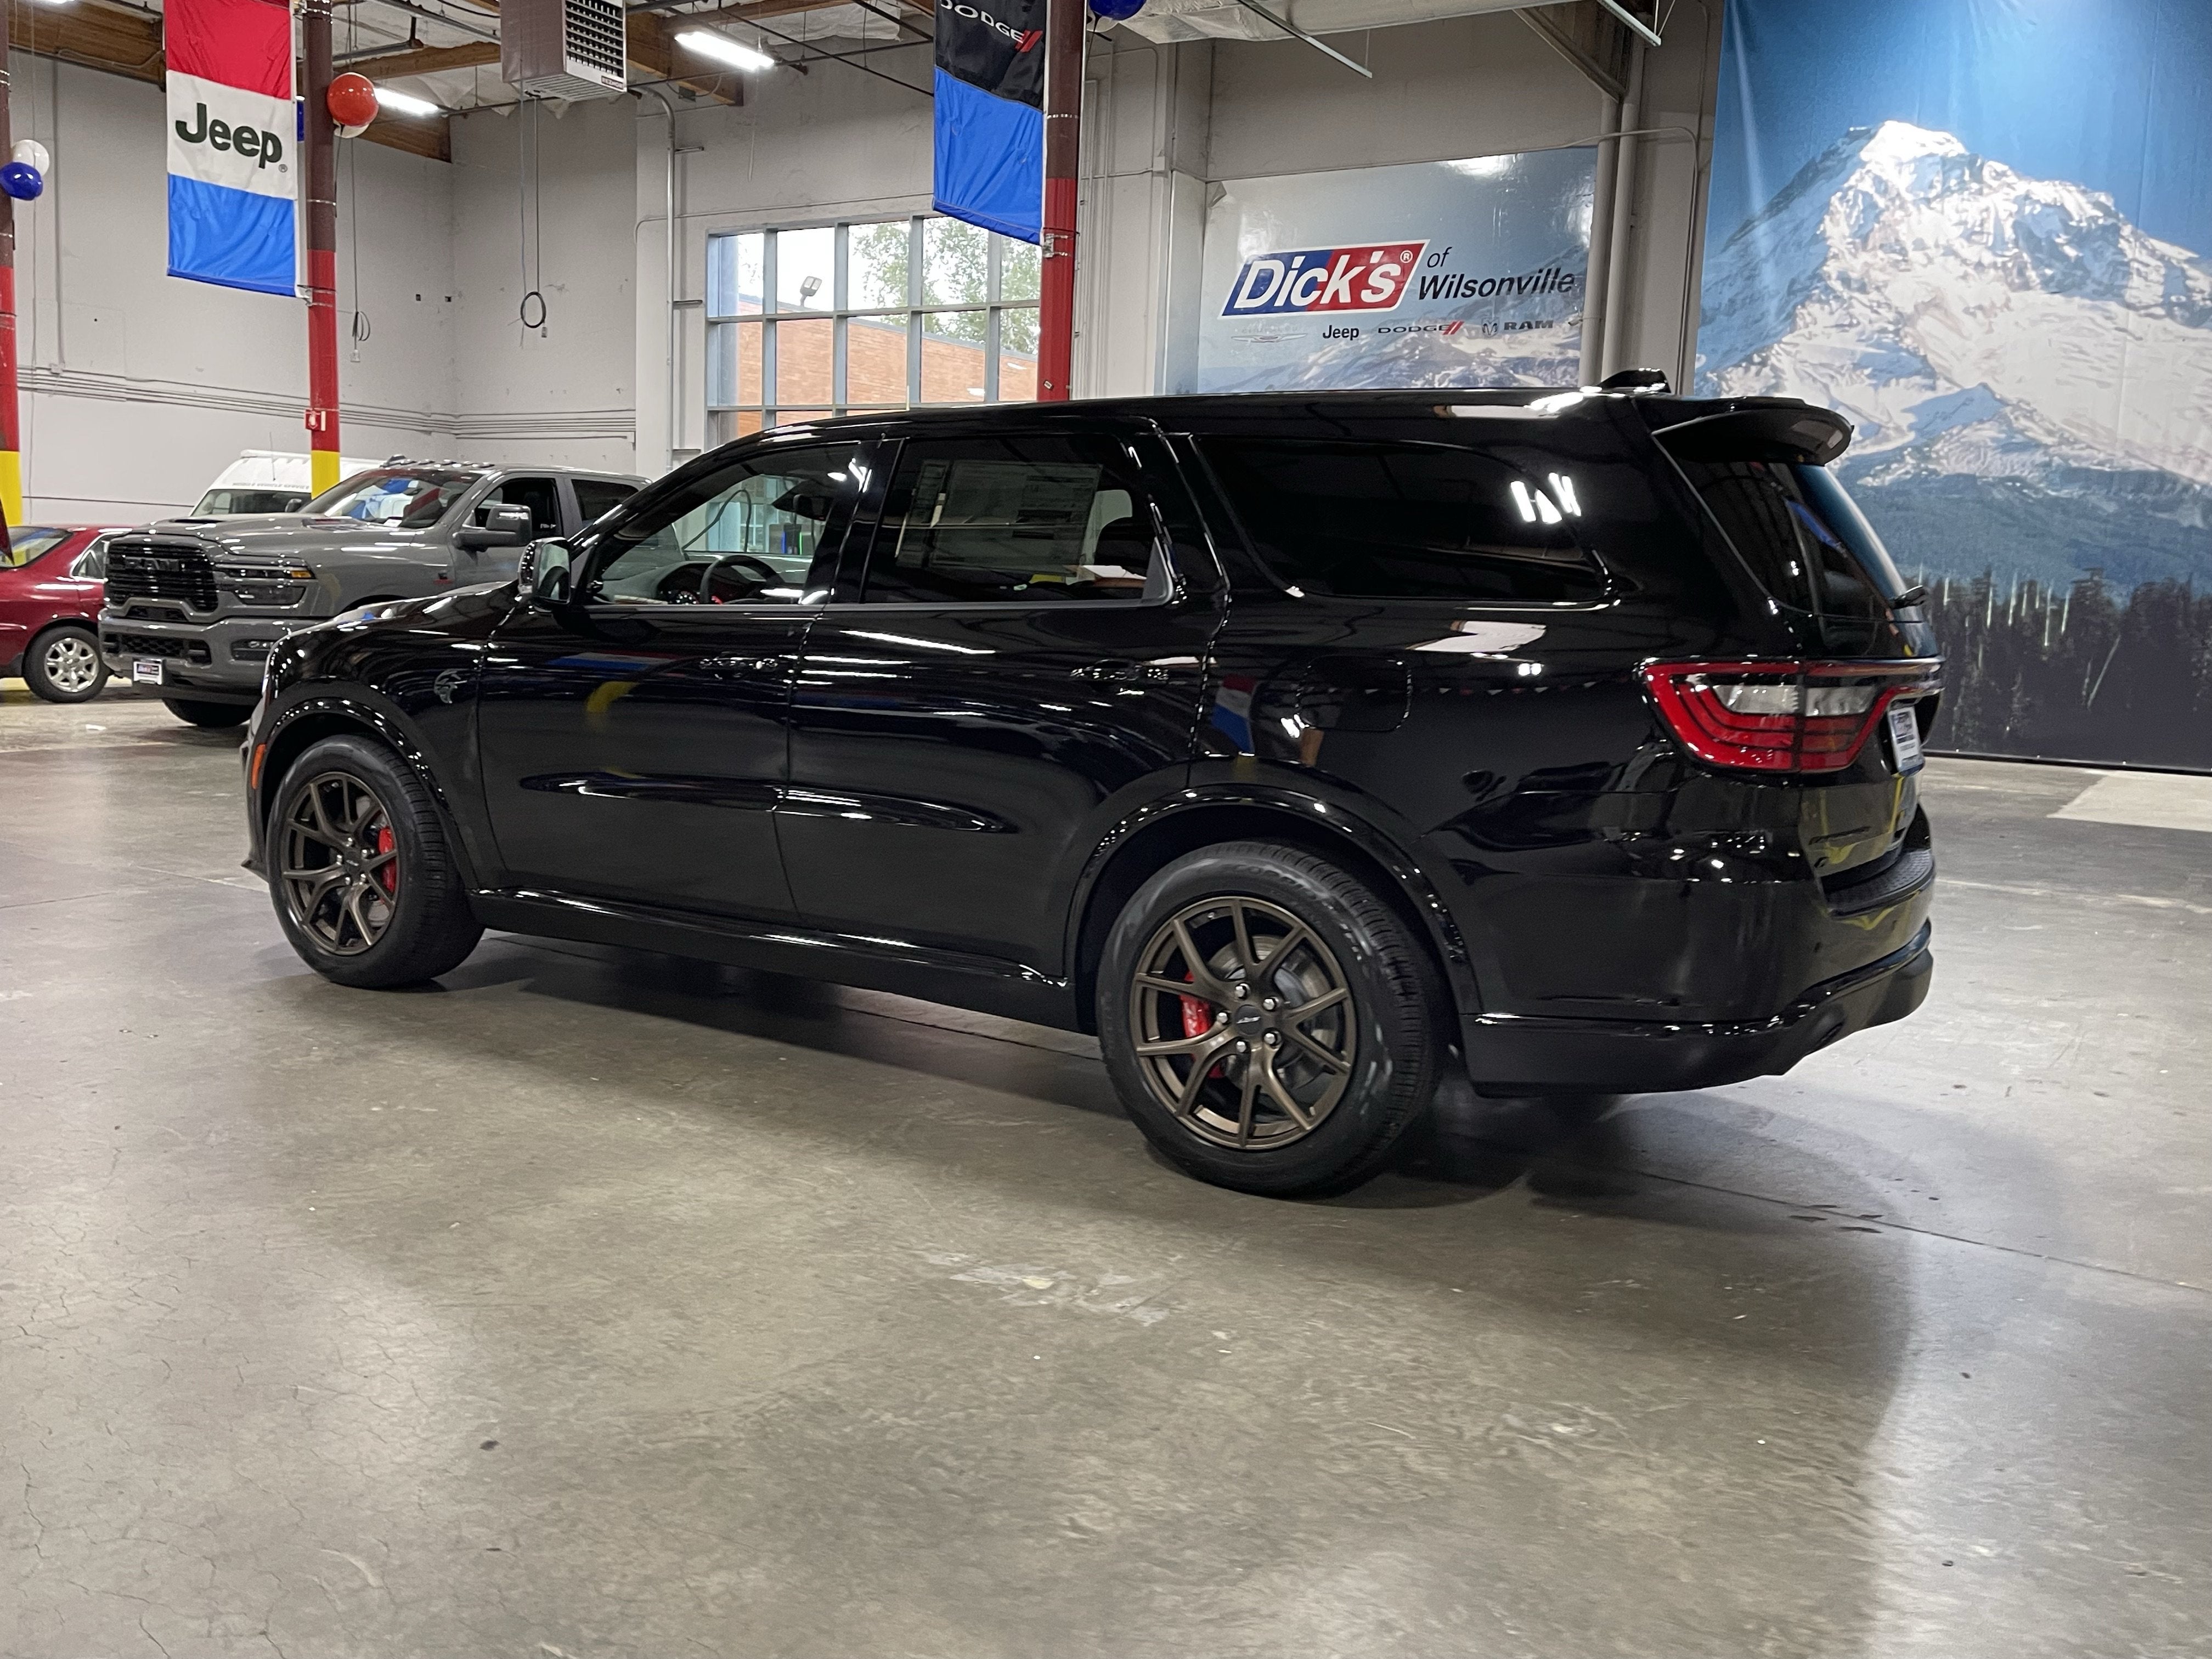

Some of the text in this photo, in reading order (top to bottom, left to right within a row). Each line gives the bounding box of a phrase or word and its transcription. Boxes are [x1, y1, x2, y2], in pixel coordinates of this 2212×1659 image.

[176, 103, 282, 169] Jeep
[1234, 247, 1453, 308] Dick's of
[1418, 267, 1575, 301] Wilsonville
[1323, 320, 1554, 340] Jeep DODGE RAM
